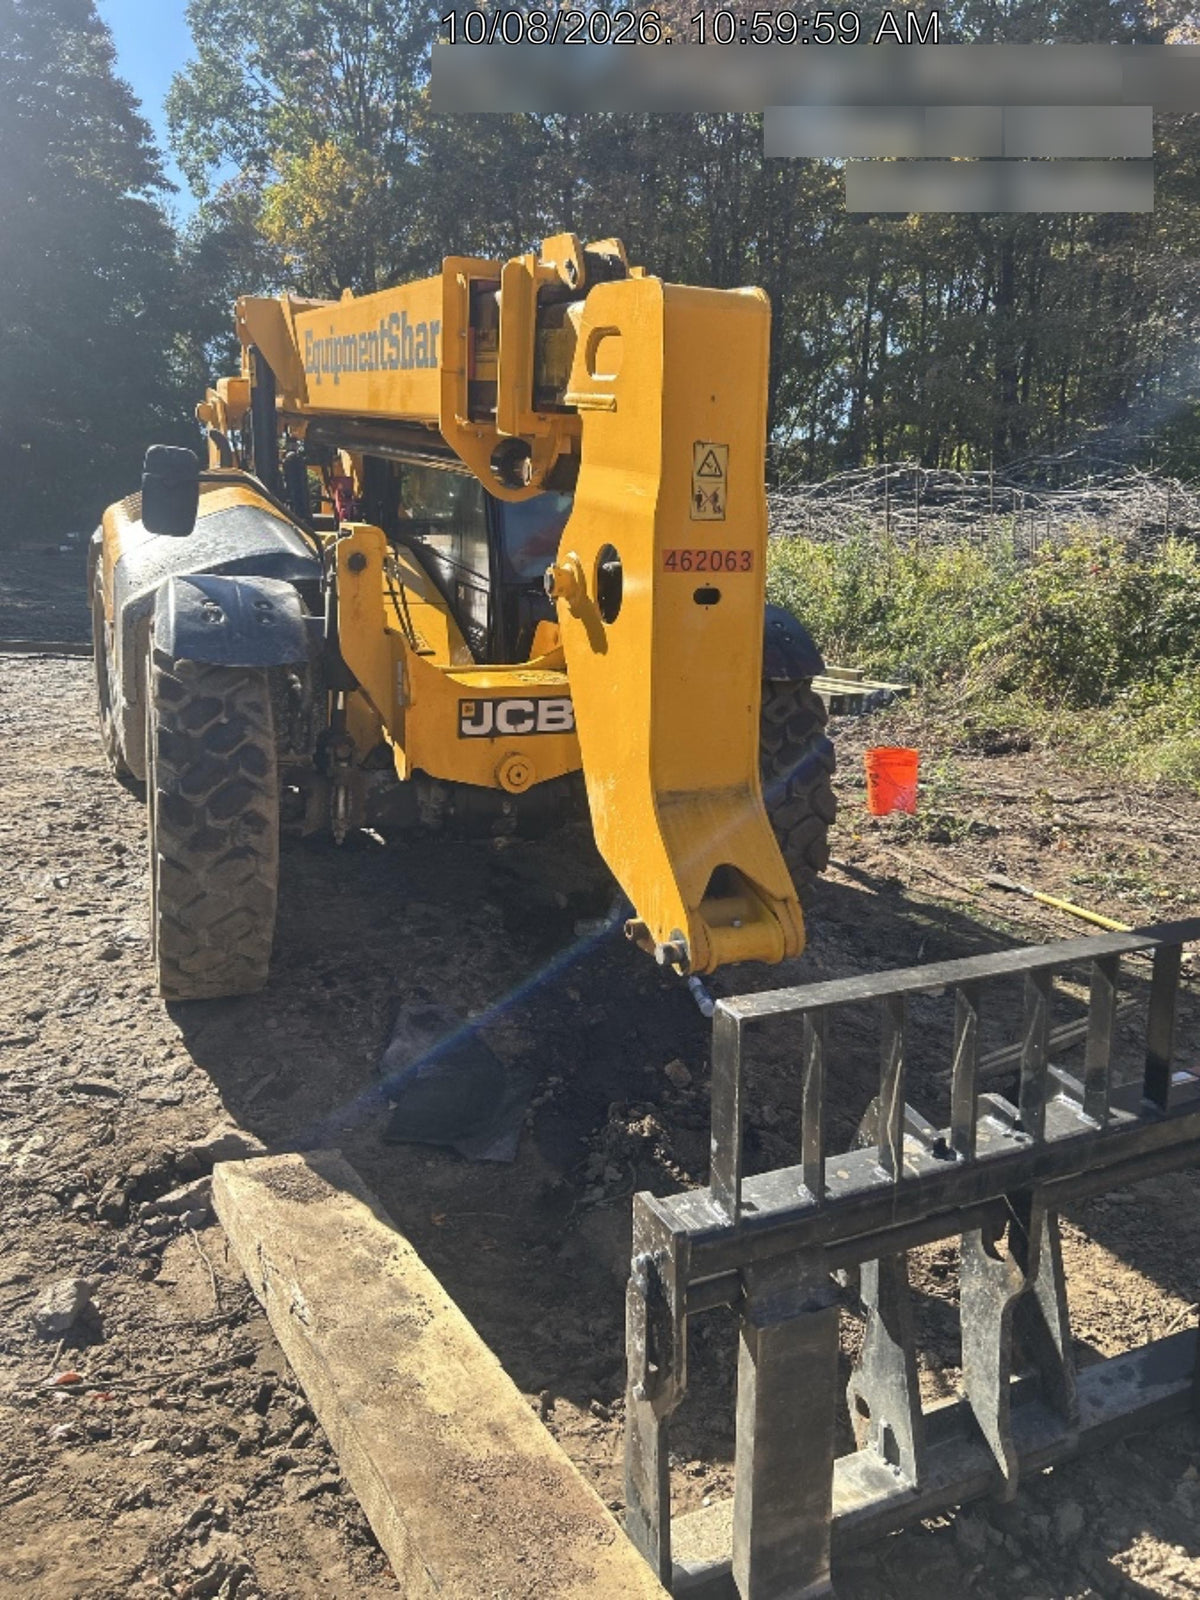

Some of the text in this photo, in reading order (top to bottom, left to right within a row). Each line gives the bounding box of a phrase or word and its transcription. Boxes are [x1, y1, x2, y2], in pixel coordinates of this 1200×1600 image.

[304, 310, 441, 385] EquipmentShar
[664, 549, 752, 572] 462063
[461, 699, 575, 735] JCB
